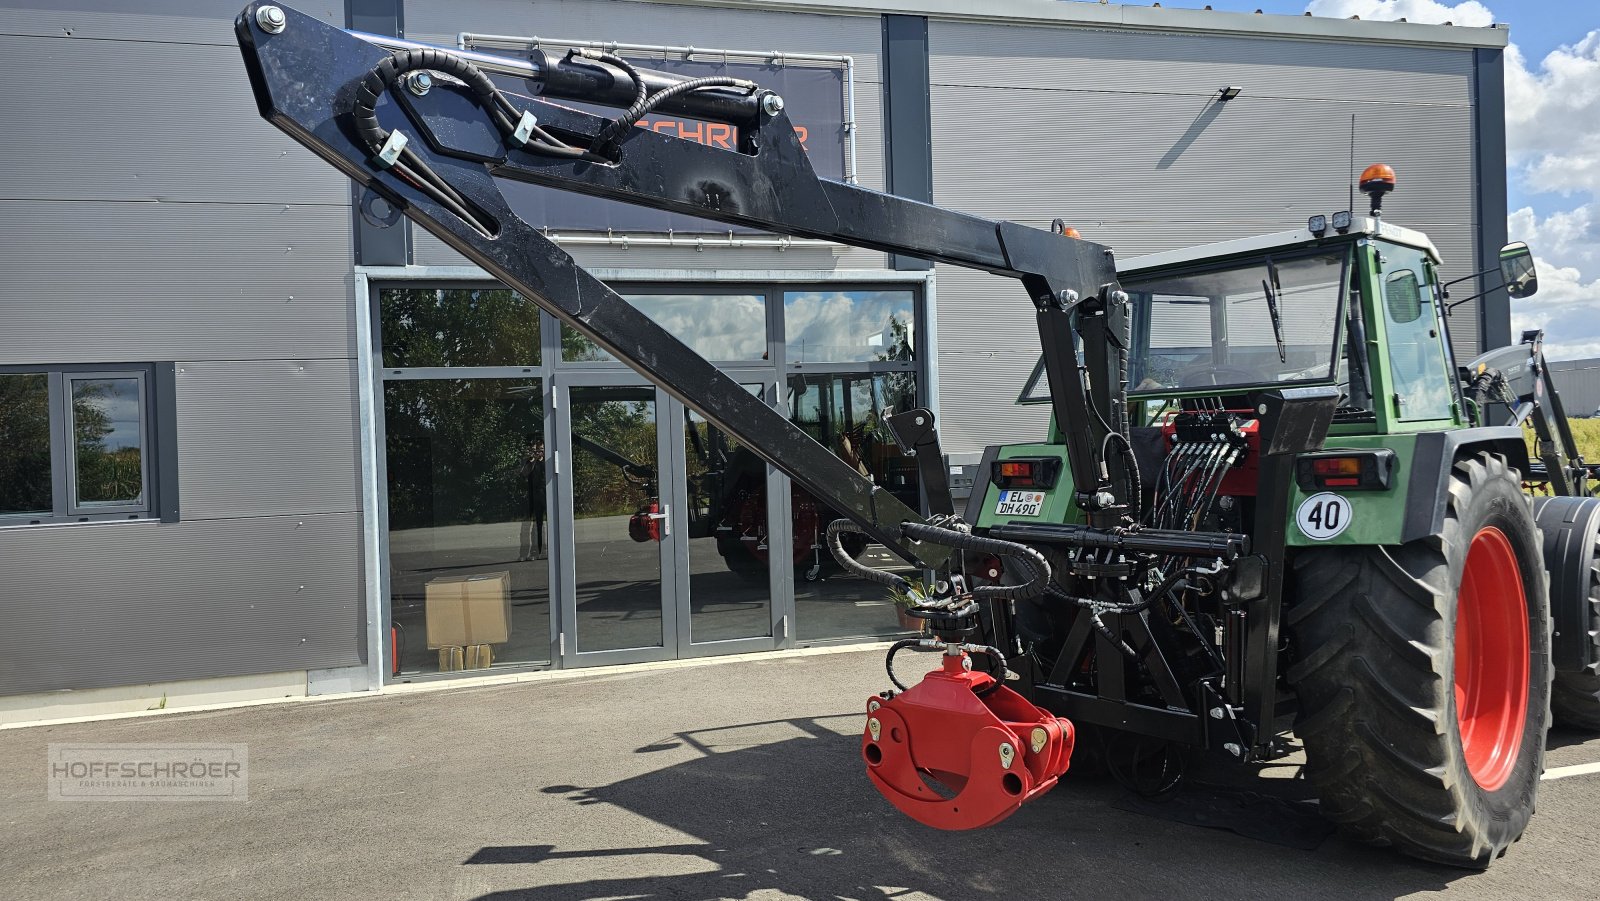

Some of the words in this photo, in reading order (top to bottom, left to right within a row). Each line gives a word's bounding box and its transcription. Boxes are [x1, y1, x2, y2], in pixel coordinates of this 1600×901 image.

[1010, 491, 1024, 502] EL
[1000, 503, 1015, 514] DH
[1015, 503, 1037, 515] 490
[1308, 500, 1341, 530] 40
